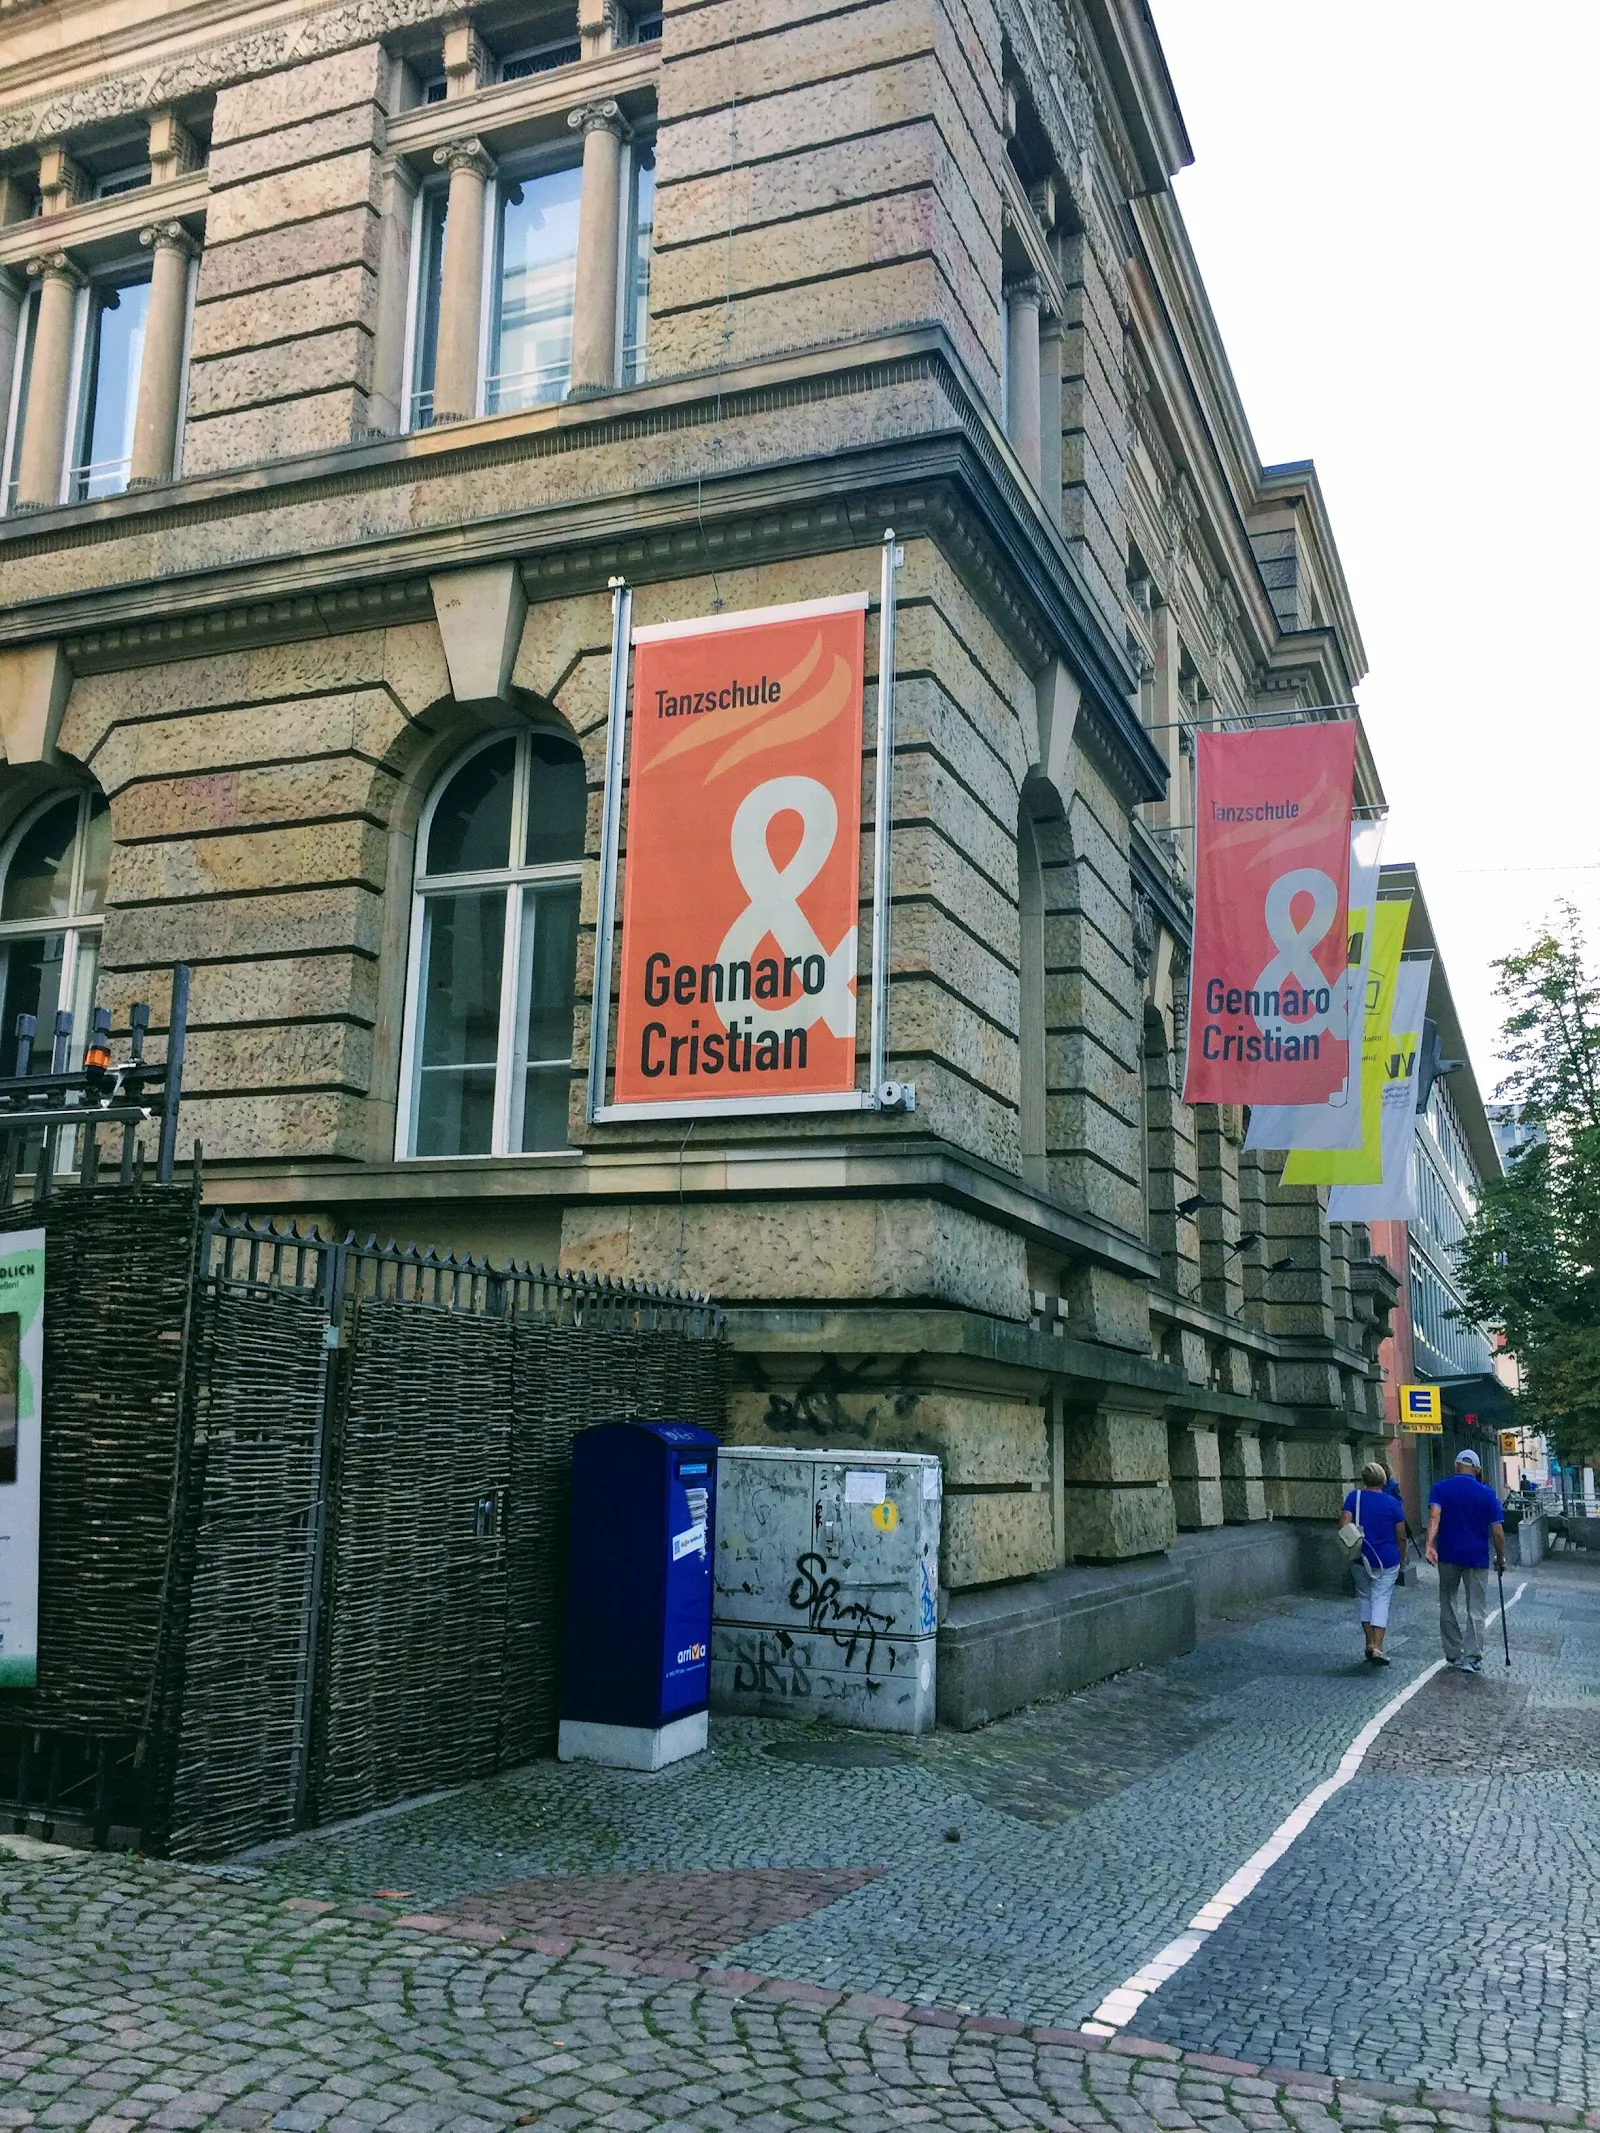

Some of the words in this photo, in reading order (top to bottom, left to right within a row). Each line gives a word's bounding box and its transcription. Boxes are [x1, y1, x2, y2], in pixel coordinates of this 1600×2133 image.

[655, 676, 781, 718] Tanzschule
[1210, 799, 1300, 822] Tanzschule
[644, 952, 826, 1007] Gennaro
[1206, 978, 1330, 1017] Gennaro
[640, 1016, 808, 1078] Cristian
[1202, 1024, 1320, 1063] Cristian
